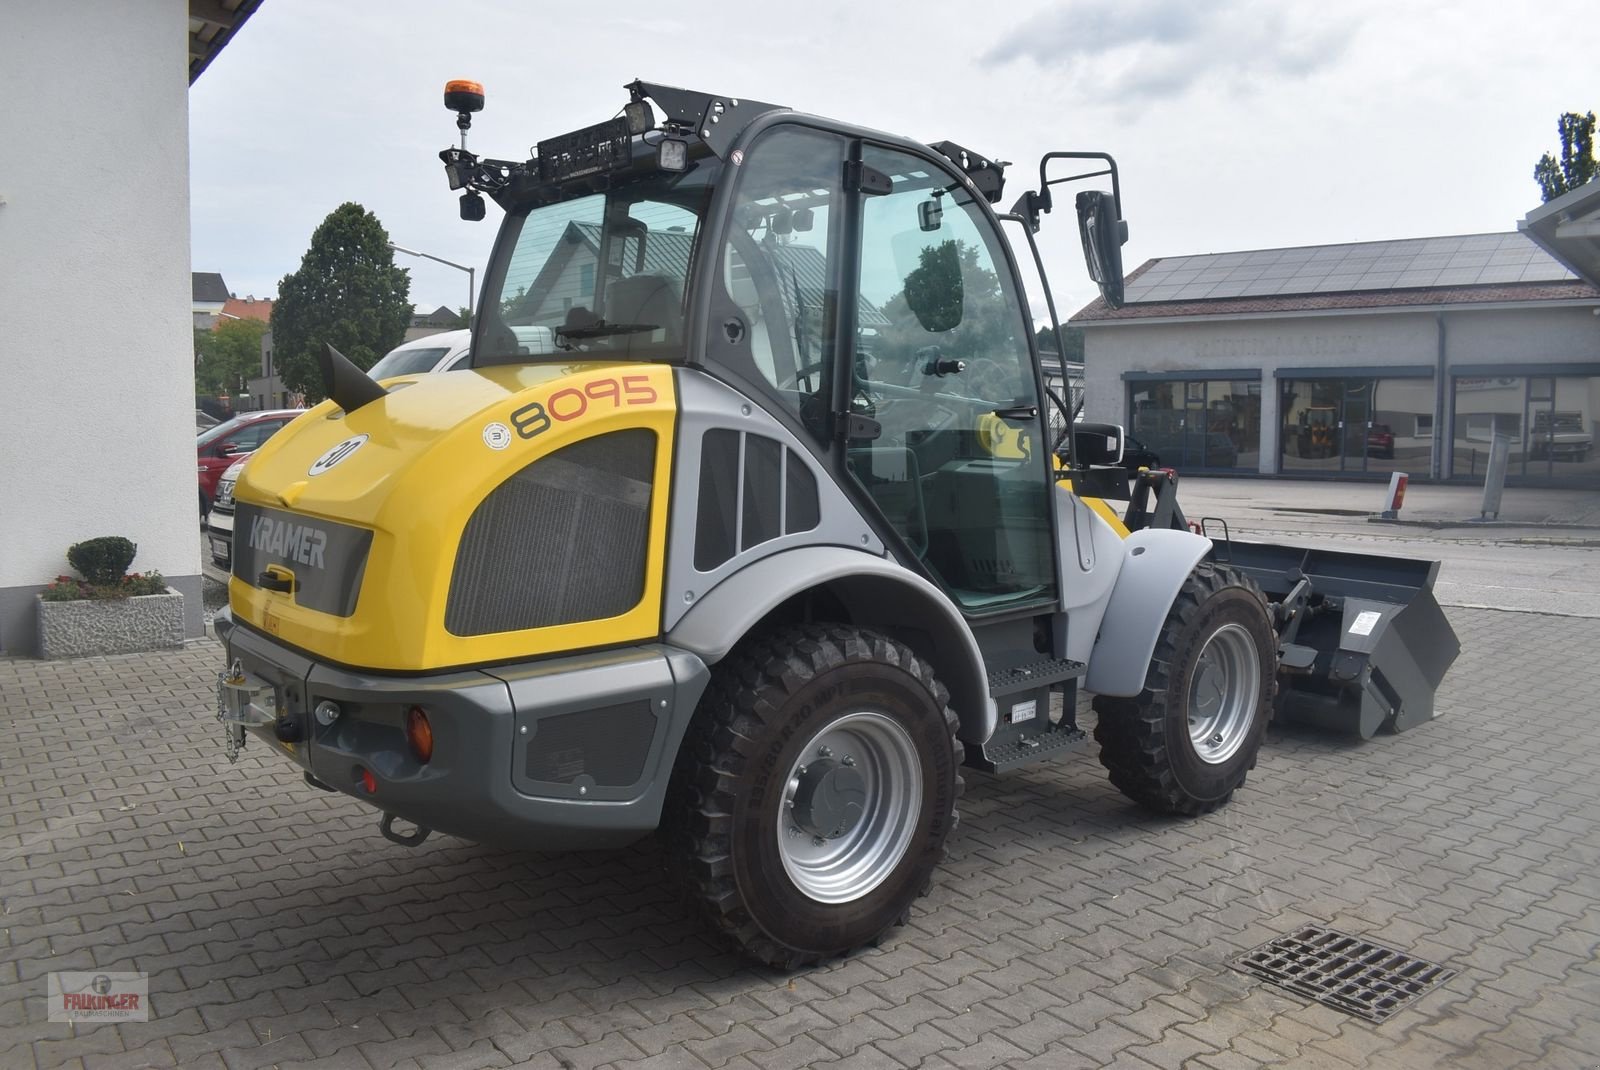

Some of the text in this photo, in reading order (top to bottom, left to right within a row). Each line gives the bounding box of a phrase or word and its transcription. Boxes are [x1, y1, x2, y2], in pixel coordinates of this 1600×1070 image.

[510, 375, 658, 440] 8095
[315, 440, 361, 469] 30
[248, 514, 328, 570] KRAMER
